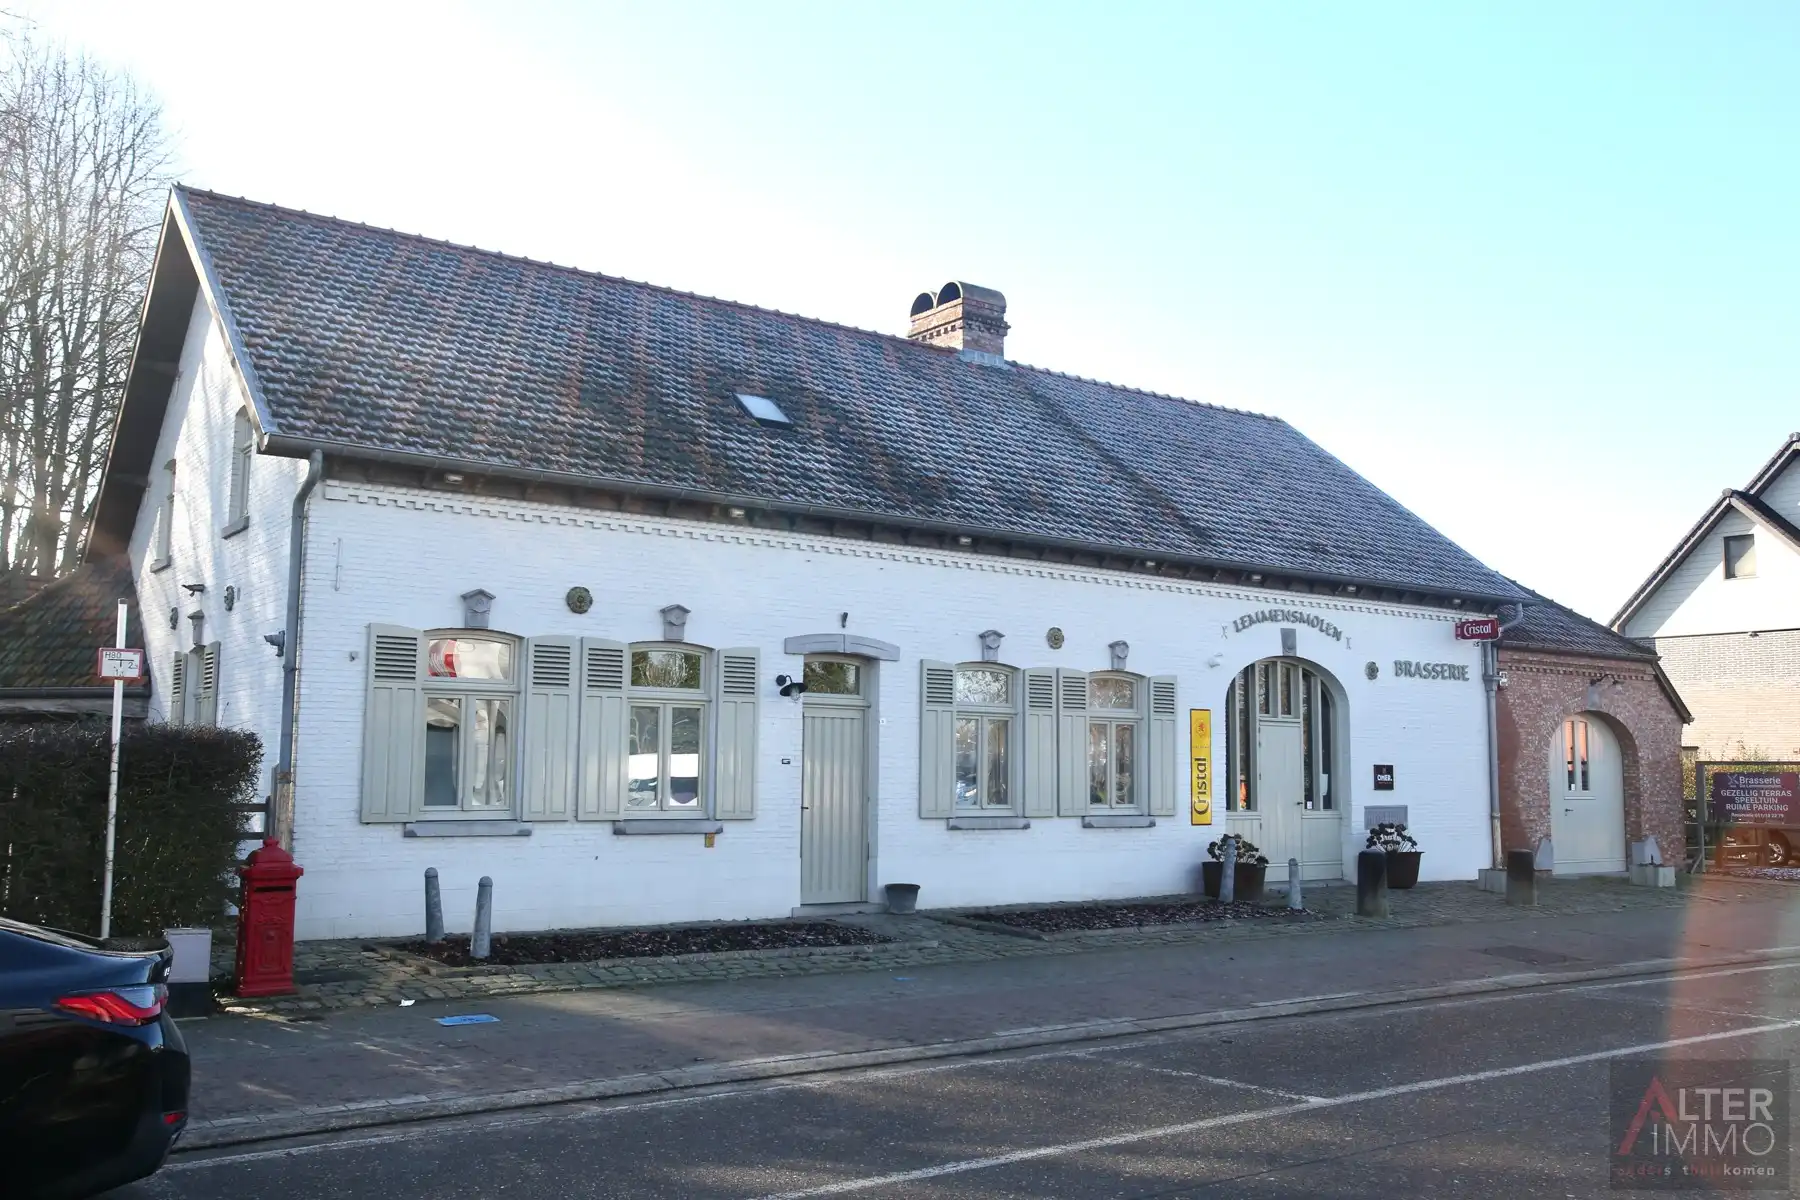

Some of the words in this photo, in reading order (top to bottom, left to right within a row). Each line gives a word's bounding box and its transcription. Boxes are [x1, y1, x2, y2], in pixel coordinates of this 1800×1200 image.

[1232, 608, 1343, 641] LEMMENSMOLEN
[1463, 622, 1492, 637] Cristal
[1394, 659, 1470, 682] BRASSERIE
[1193, 757, 1210, 815] Cristal
[1739, 776, 1781, 785] Brasserie
[1720, 789, 1758, 797] GEZELLIG
[1760, 789, 1792, 797] TERRAS
[1734, 796, 1778, 804] SPEELTUIN
[1725, 803, 1751, 811] RUIME
